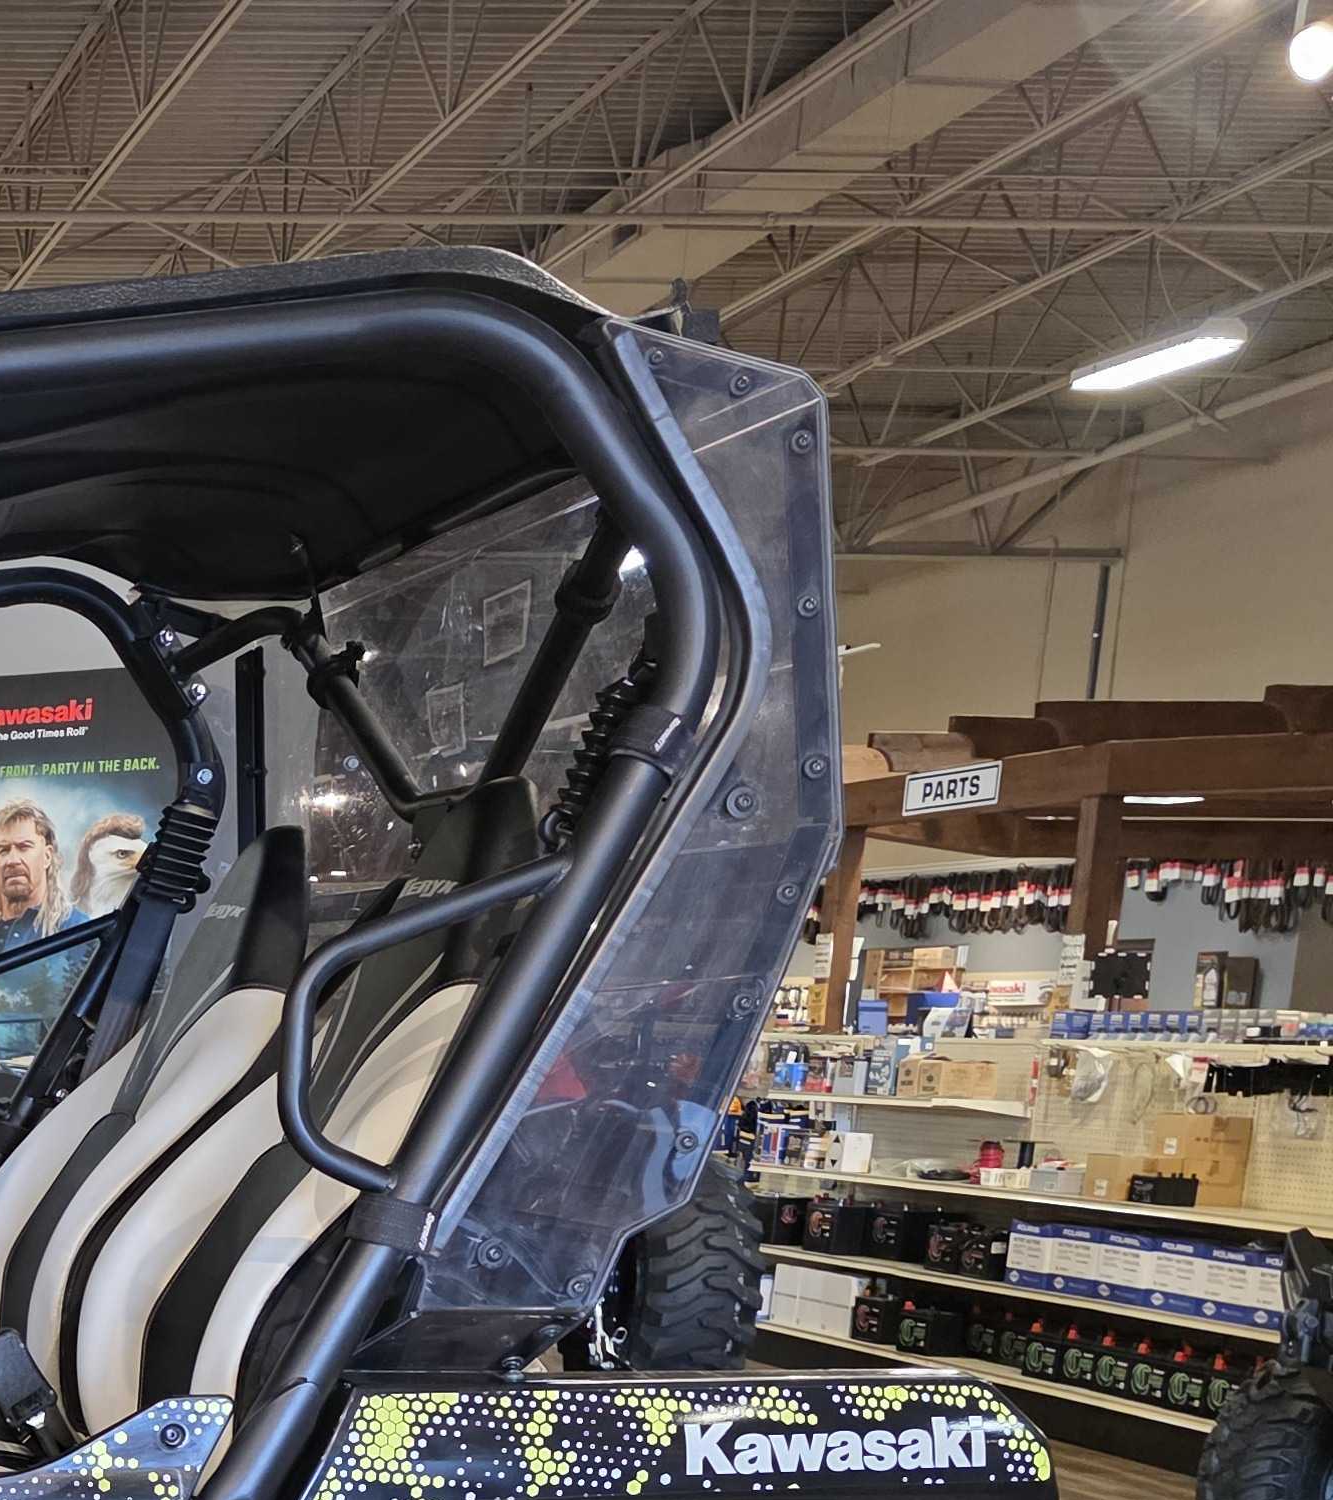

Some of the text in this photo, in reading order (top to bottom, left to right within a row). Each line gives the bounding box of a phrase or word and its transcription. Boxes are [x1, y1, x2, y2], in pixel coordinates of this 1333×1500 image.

[10, 730, 35, 740] Good
[37, 728, 65, 738] Times
[66, 726, 86, 736] Roll
[0, 763, 40, 779] FRONT.
[42, 761, 79, 776] PARTY
[82, 759, 96, 774] IN
[98, 758, 122, 774] THE
[124, 757, 161, 771] BACK.
[921, 774, 981, 803] PARTS
[683, 1414, 988, 1476] Kawasaki
